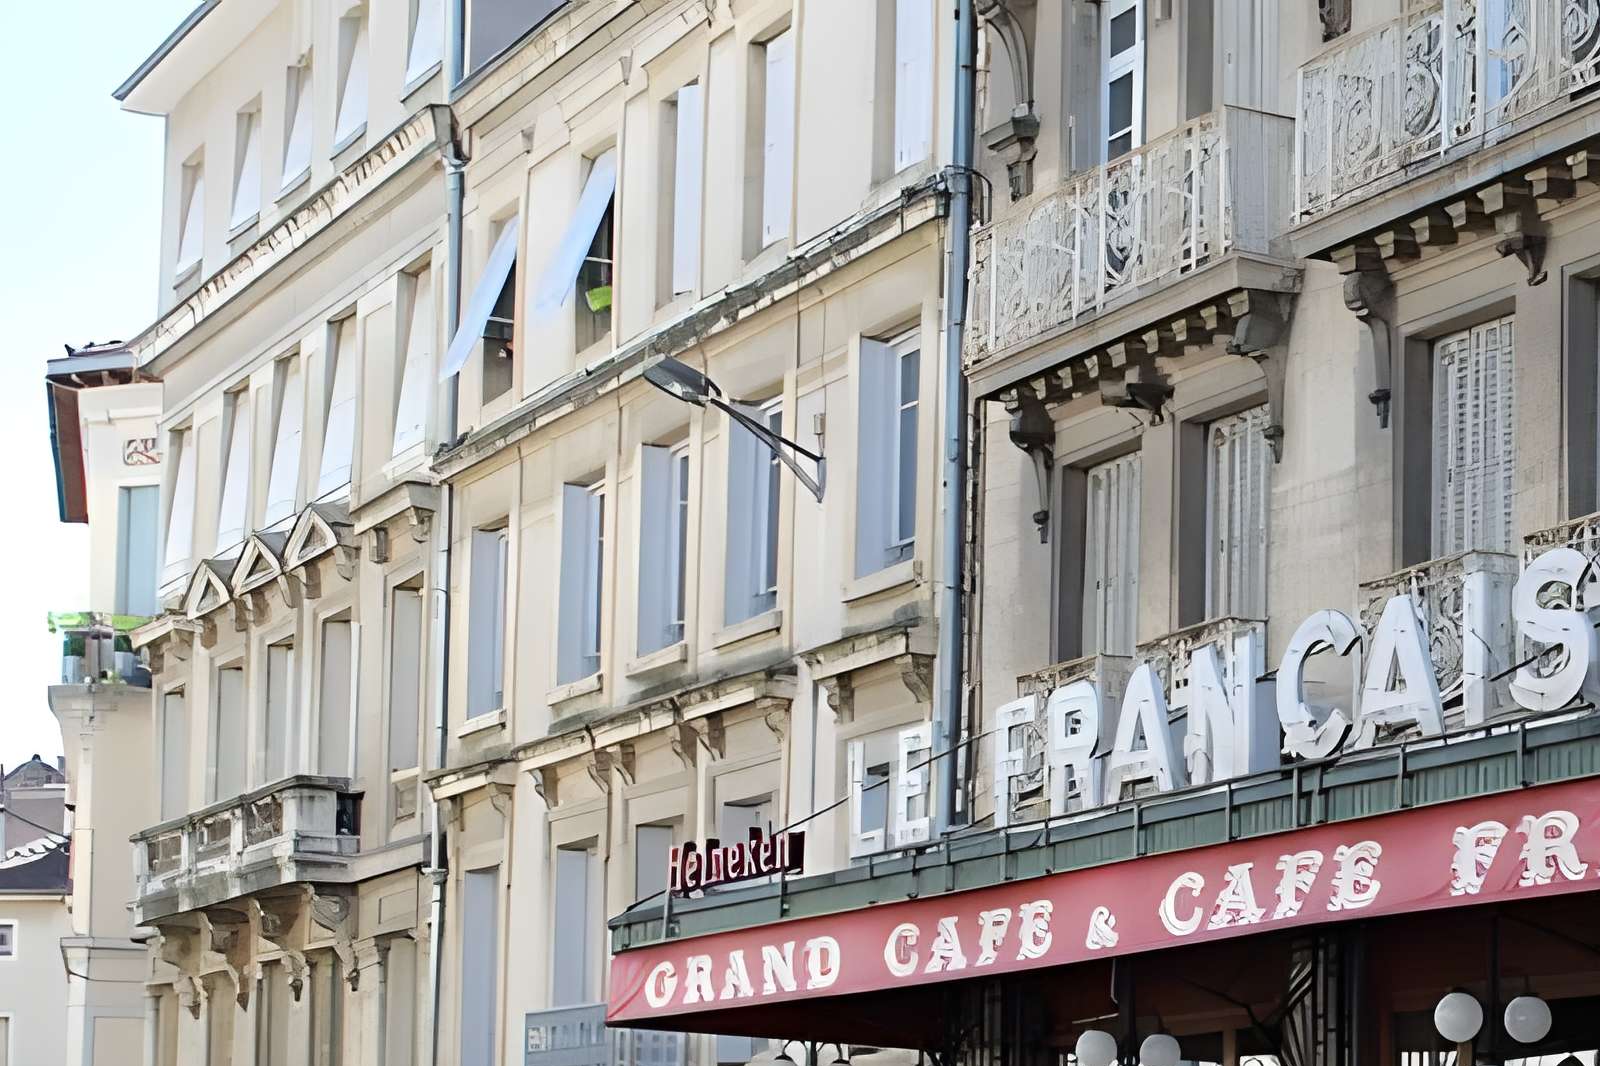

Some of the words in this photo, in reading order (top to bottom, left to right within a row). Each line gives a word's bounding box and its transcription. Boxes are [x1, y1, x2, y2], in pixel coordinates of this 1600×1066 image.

[848, 720, 934, 858] LE
[668, 827, 798, 892] Heineken
[644, 935, 842, 1009] GRAND
[1086, 905, 1120, 951] &
